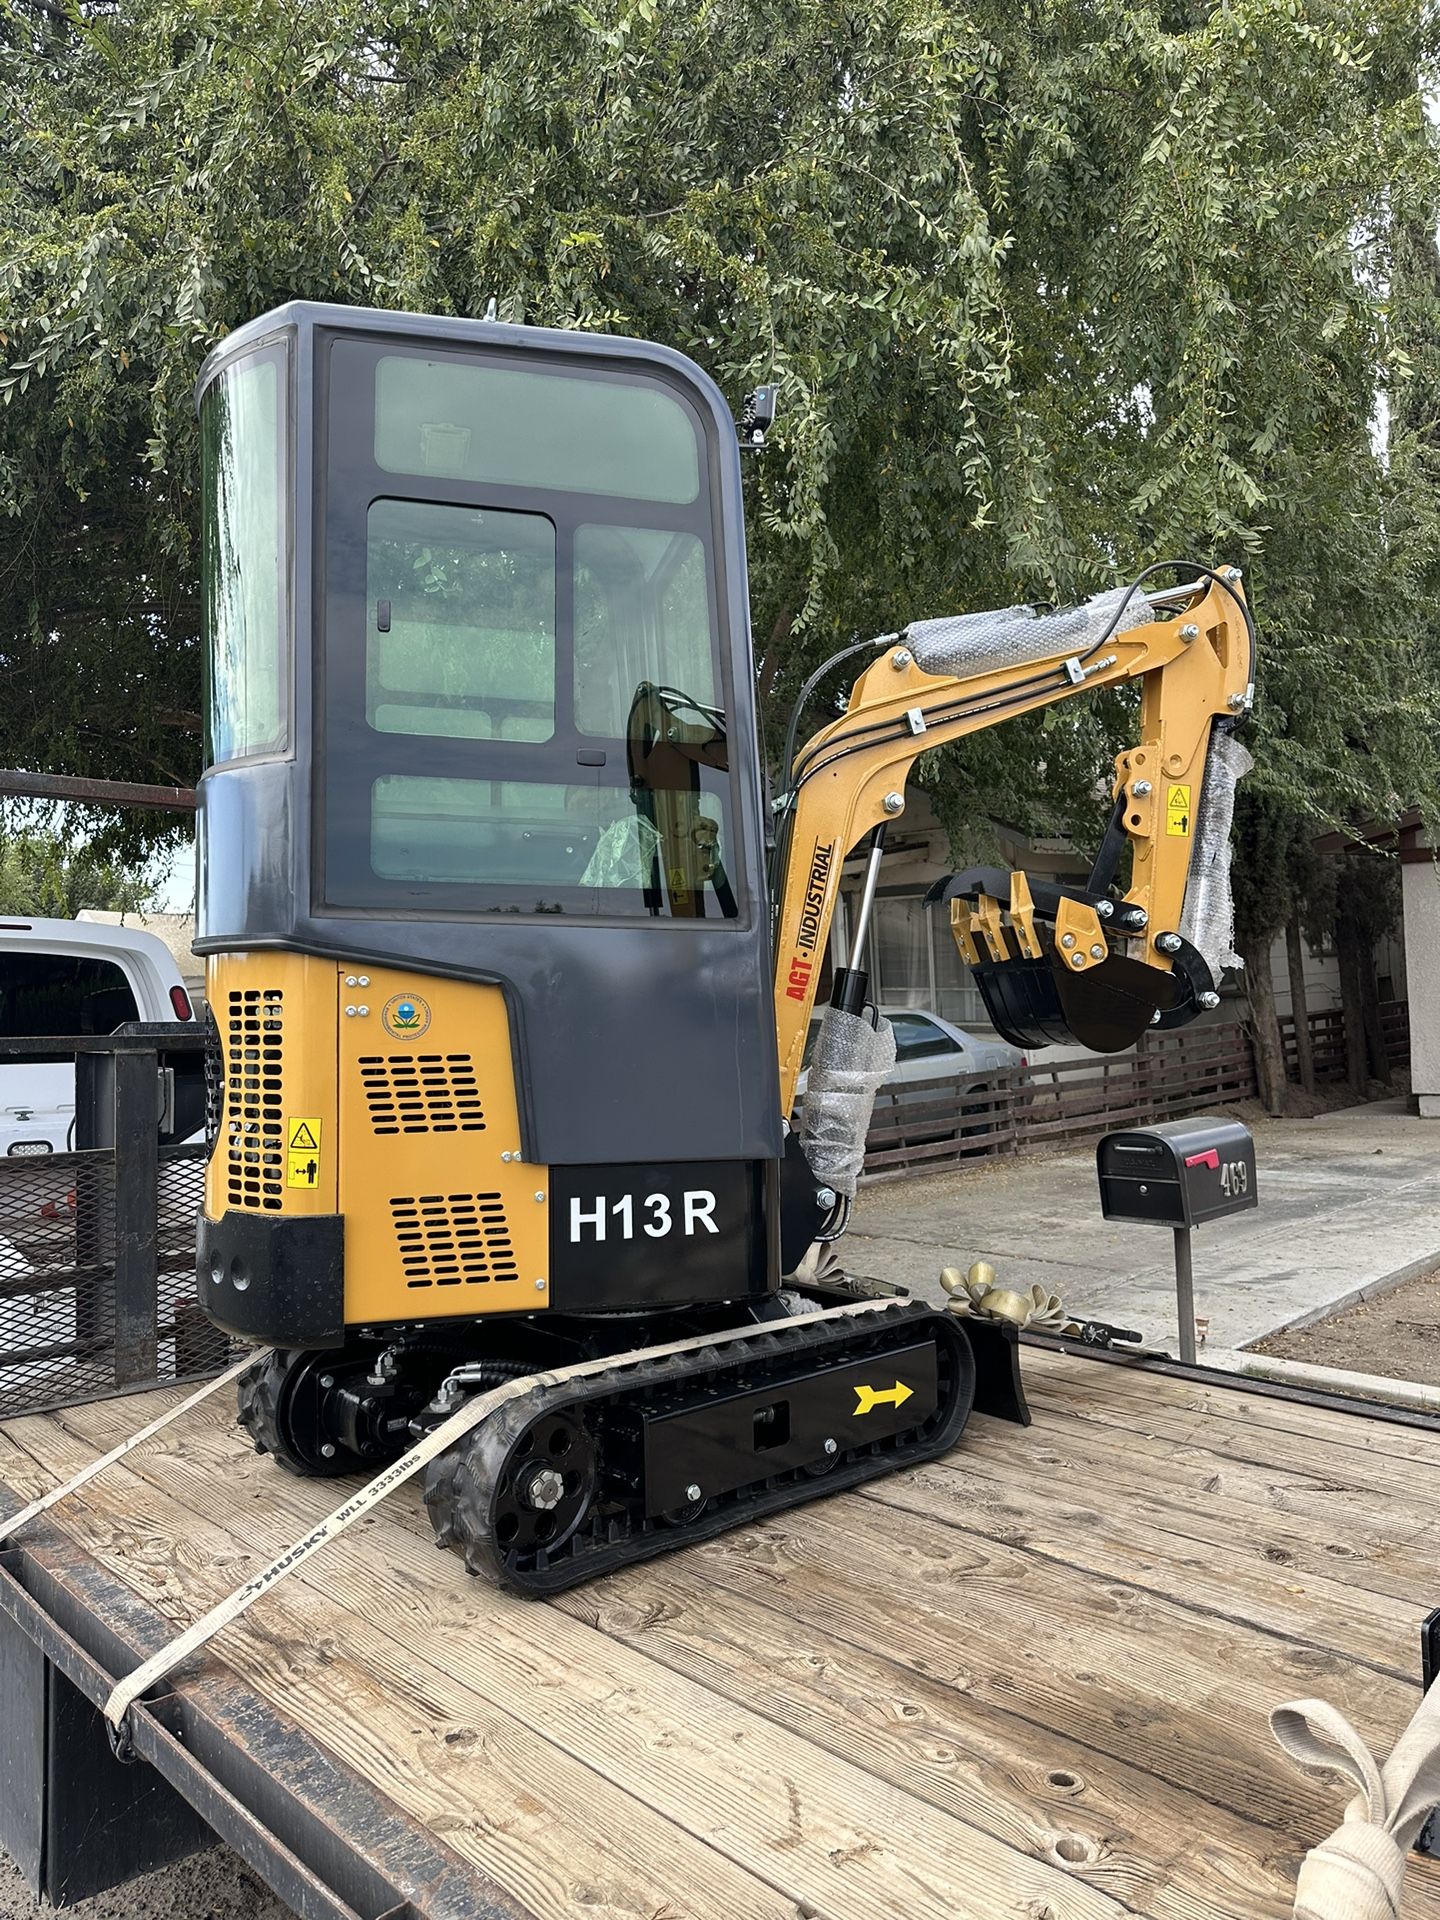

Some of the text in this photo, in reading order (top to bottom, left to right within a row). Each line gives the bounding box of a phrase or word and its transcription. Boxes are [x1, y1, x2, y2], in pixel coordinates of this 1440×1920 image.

[785, 843, 833, 1002] AGT INDUSTRIAL
[569, 1189, 720, 1243] H13R
[1219, 1160, 1248, 1197] 469
[262, 1453, 422, 1584] HUSKY WLL 3333lbs
